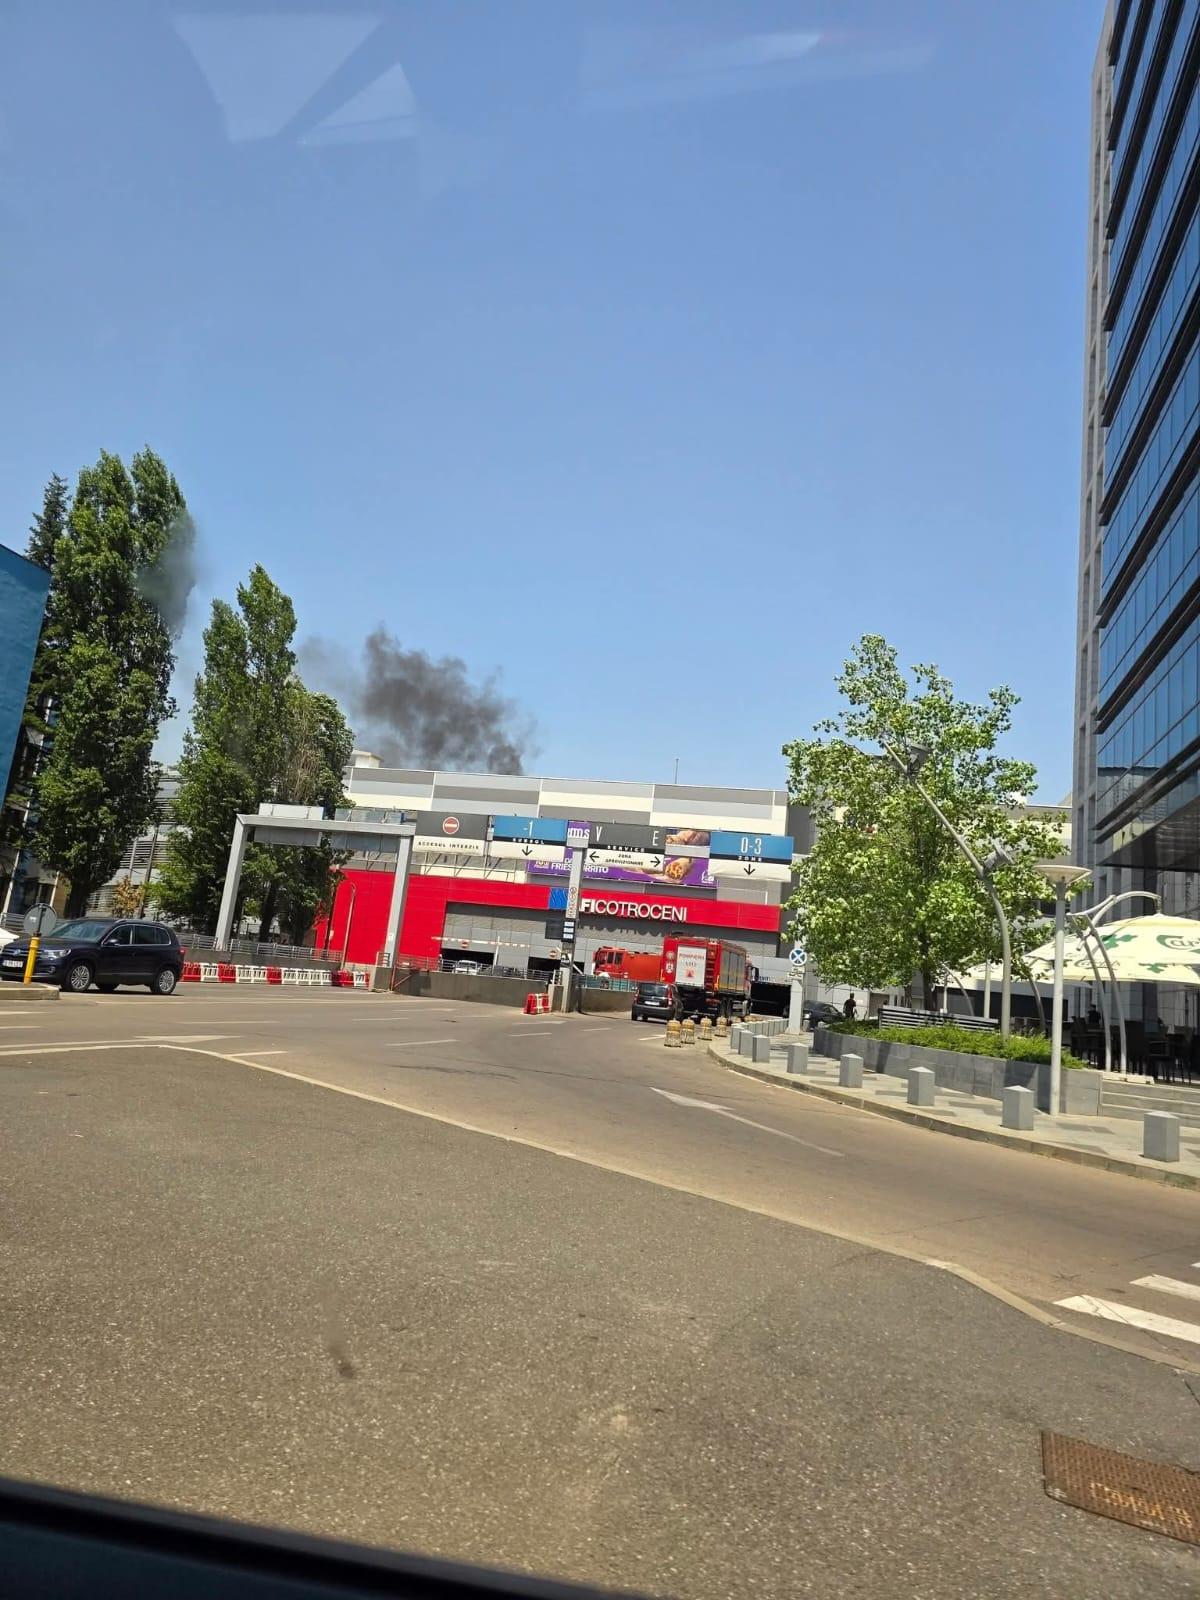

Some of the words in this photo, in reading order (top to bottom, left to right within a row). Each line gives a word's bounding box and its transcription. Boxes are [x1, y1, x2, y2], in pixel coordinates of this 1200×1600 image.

[523, 819, 534, 839] -1
[596, 826, 603, 842] V
[652, 830, 660, 846] E
[740, 836, 763, 855] 0-3
[551, 862, 573, 872] FRIES
[584, 863, 609, 874] RRITO
